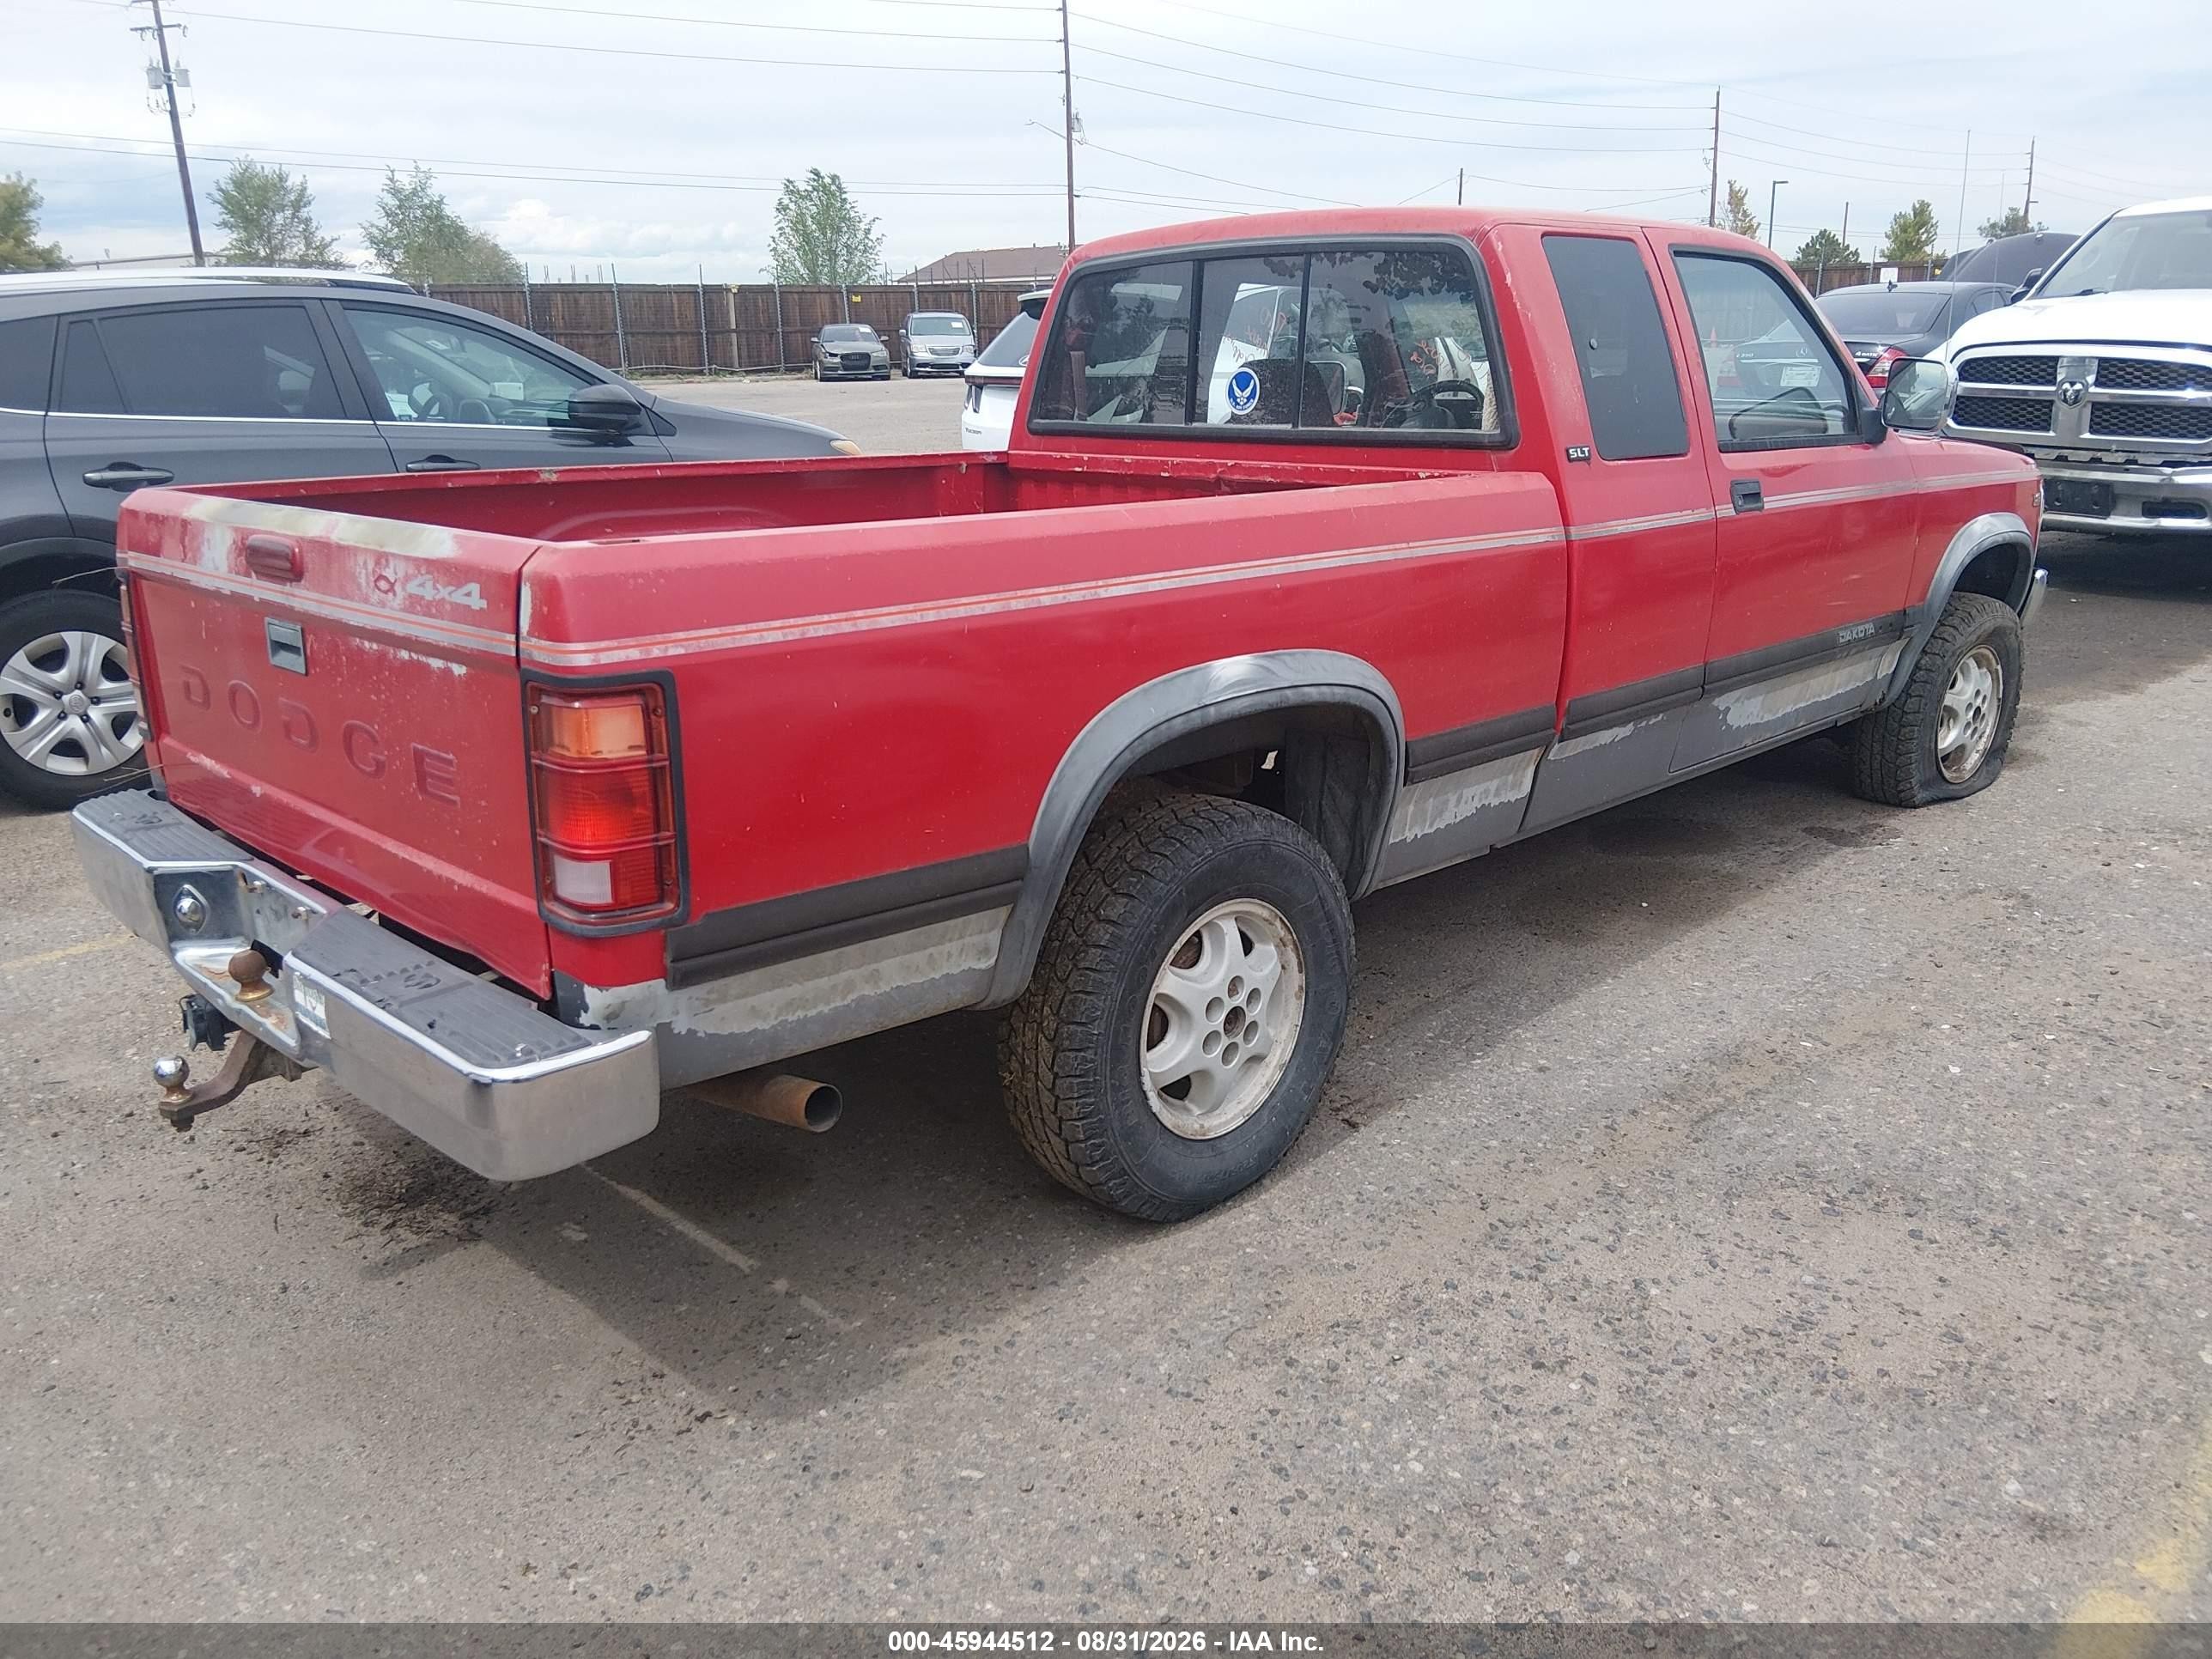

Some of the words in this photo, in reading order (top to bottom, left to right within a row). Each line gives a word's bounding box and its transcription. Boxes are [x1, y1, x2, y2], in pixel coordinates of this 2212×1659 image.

[1568, 447, 1590, 459] SLT
[406, 574, 488, 611] 4x4
[1838, 622, 1875, 644] DAKOTA
[180, 665, 462, 810] DODGE
